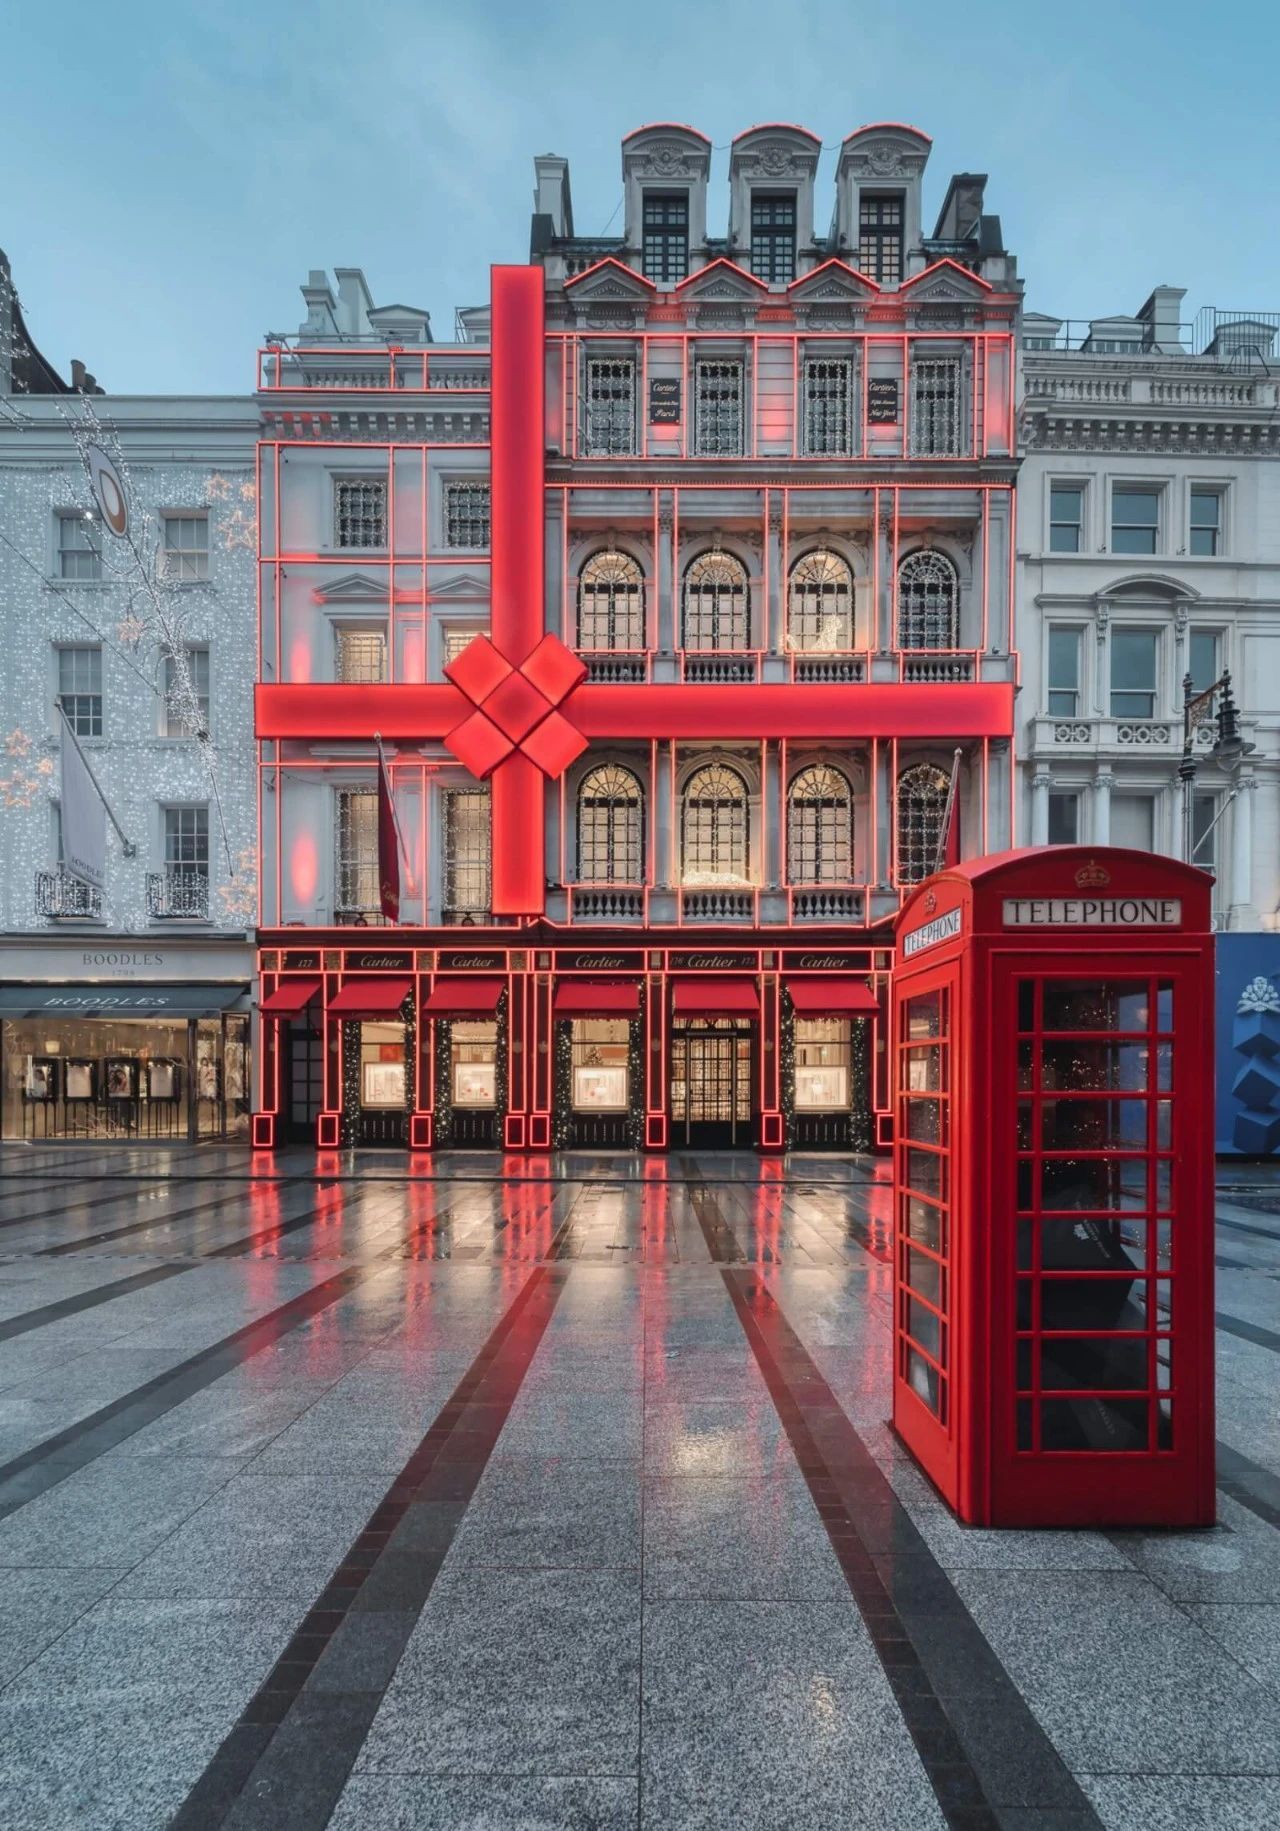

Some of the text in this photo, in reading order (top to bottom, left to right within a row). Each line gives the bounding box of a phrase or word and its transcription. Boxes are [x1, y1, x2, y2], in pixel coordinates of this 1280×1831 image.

[653, 383, 678, 392] Cartier
[1009, 900, 1174, 923] TELEPHONE
[906, 910, 960, 953] TELEPHONE
[82, 953, 164, 966] BOODLES
[360, 955, 404, 968] Cartier
[451, 955, 495, 968] Cartier
[575, 954, 624, 968] Cartier
[688, 954, 736, 968] Cartier
[799, 954, 849, 968] Cartier
[44, 997, 170, 1006] BOODLES
